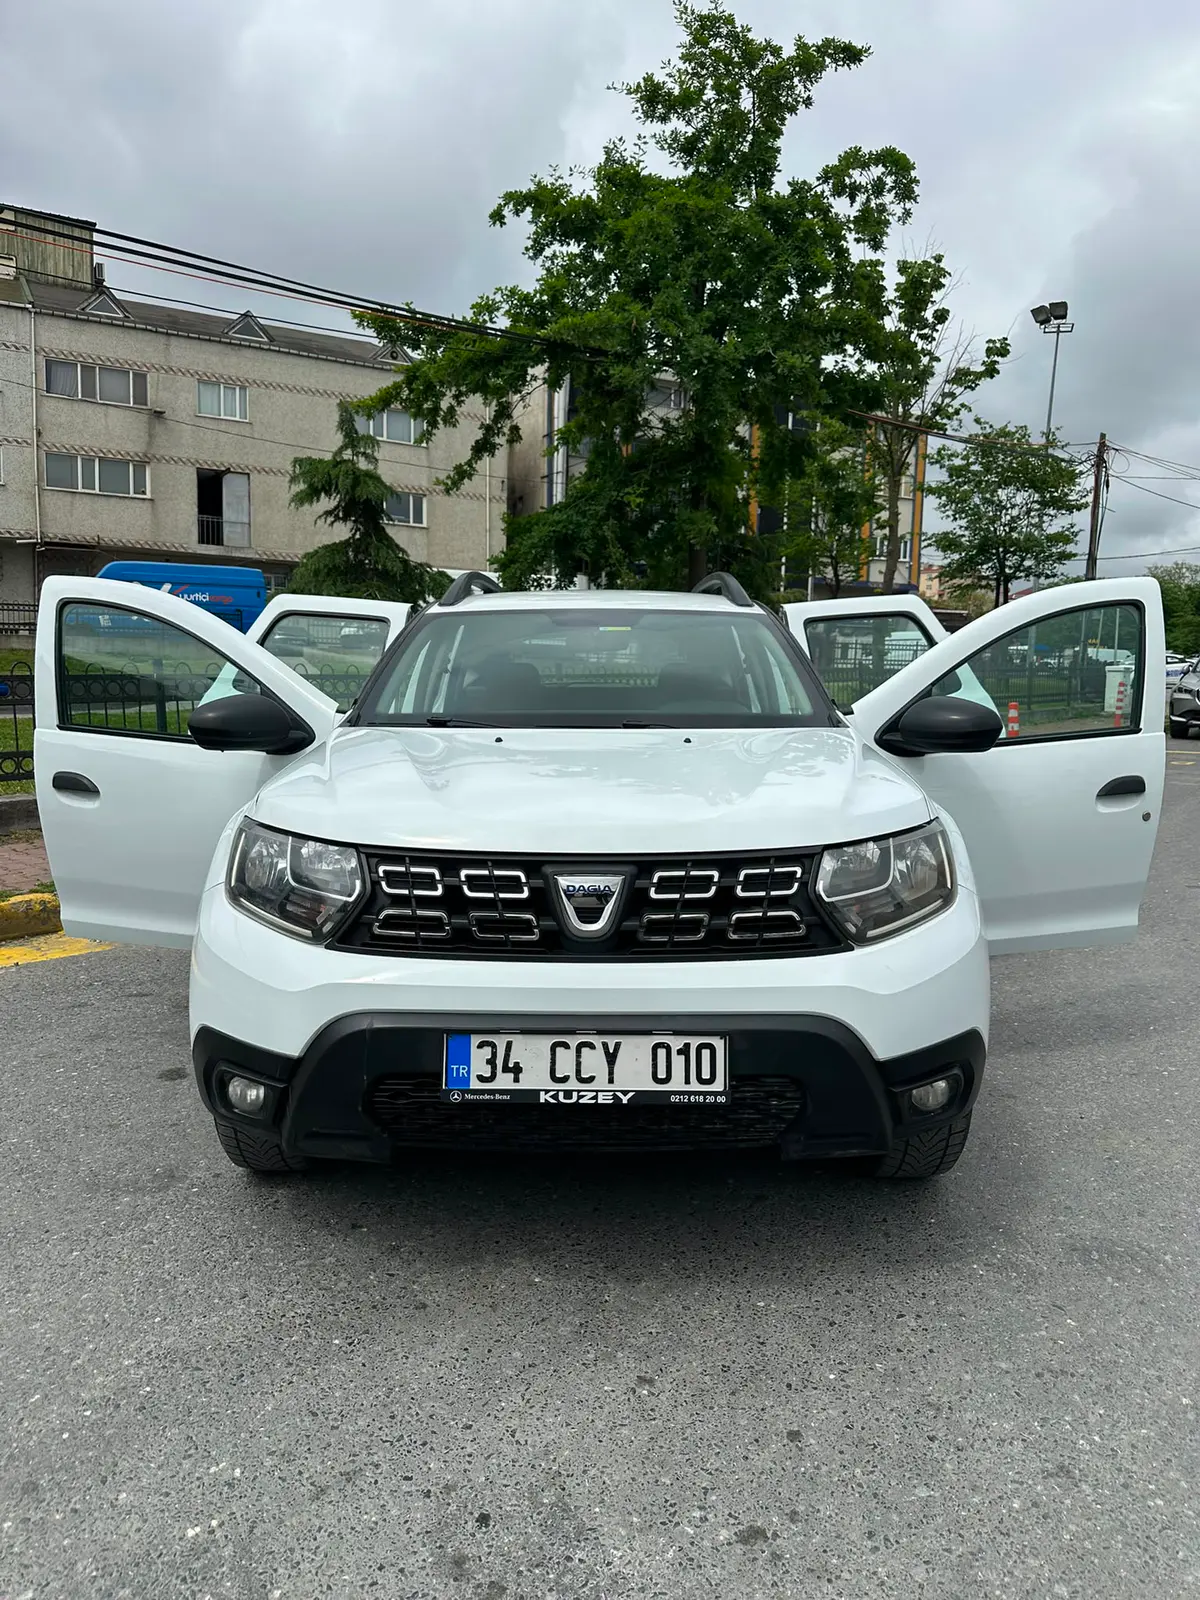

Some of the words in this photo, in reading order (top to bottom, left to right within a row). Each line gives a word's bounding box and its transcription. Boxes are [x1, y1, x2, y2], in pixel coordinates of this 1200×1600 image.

[475, 1040, 523, 1084] 34
[549, 1040, 622, 1085] CCY
[651, 1041, 717, 1086] 010
[450, 1065, 468, 1078] TR
[539, 1090, 636, 1104] KUZEY
[705, 1095, 715, 1103] 20
[716, 1095, 726, 1103] 00
